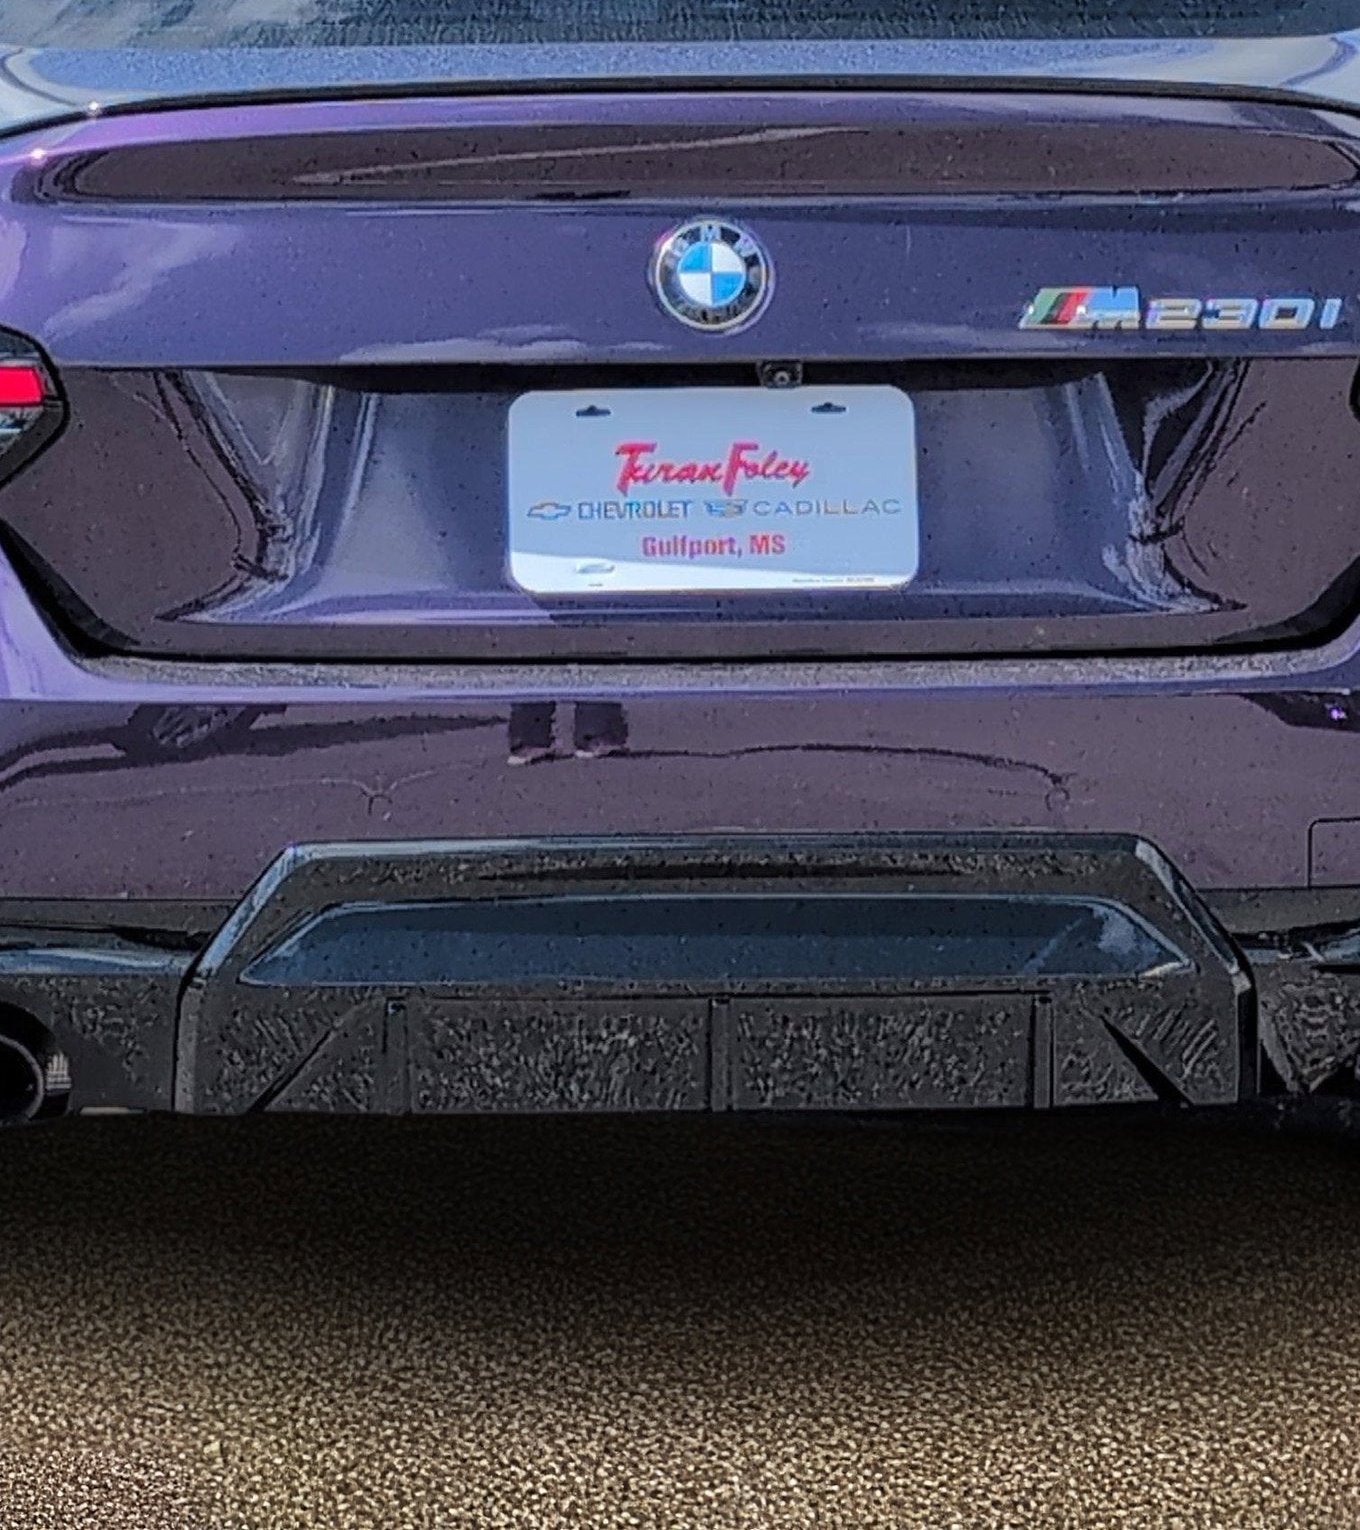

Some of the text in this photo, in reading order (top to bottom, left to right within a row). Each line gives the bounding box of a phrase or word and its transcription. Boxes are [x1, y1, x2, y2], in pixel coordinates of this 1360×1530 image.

[577, 498, 902, 521] CHEVROLET CADILLAC
[642, 534, 786, 559] Gulfport, MS
